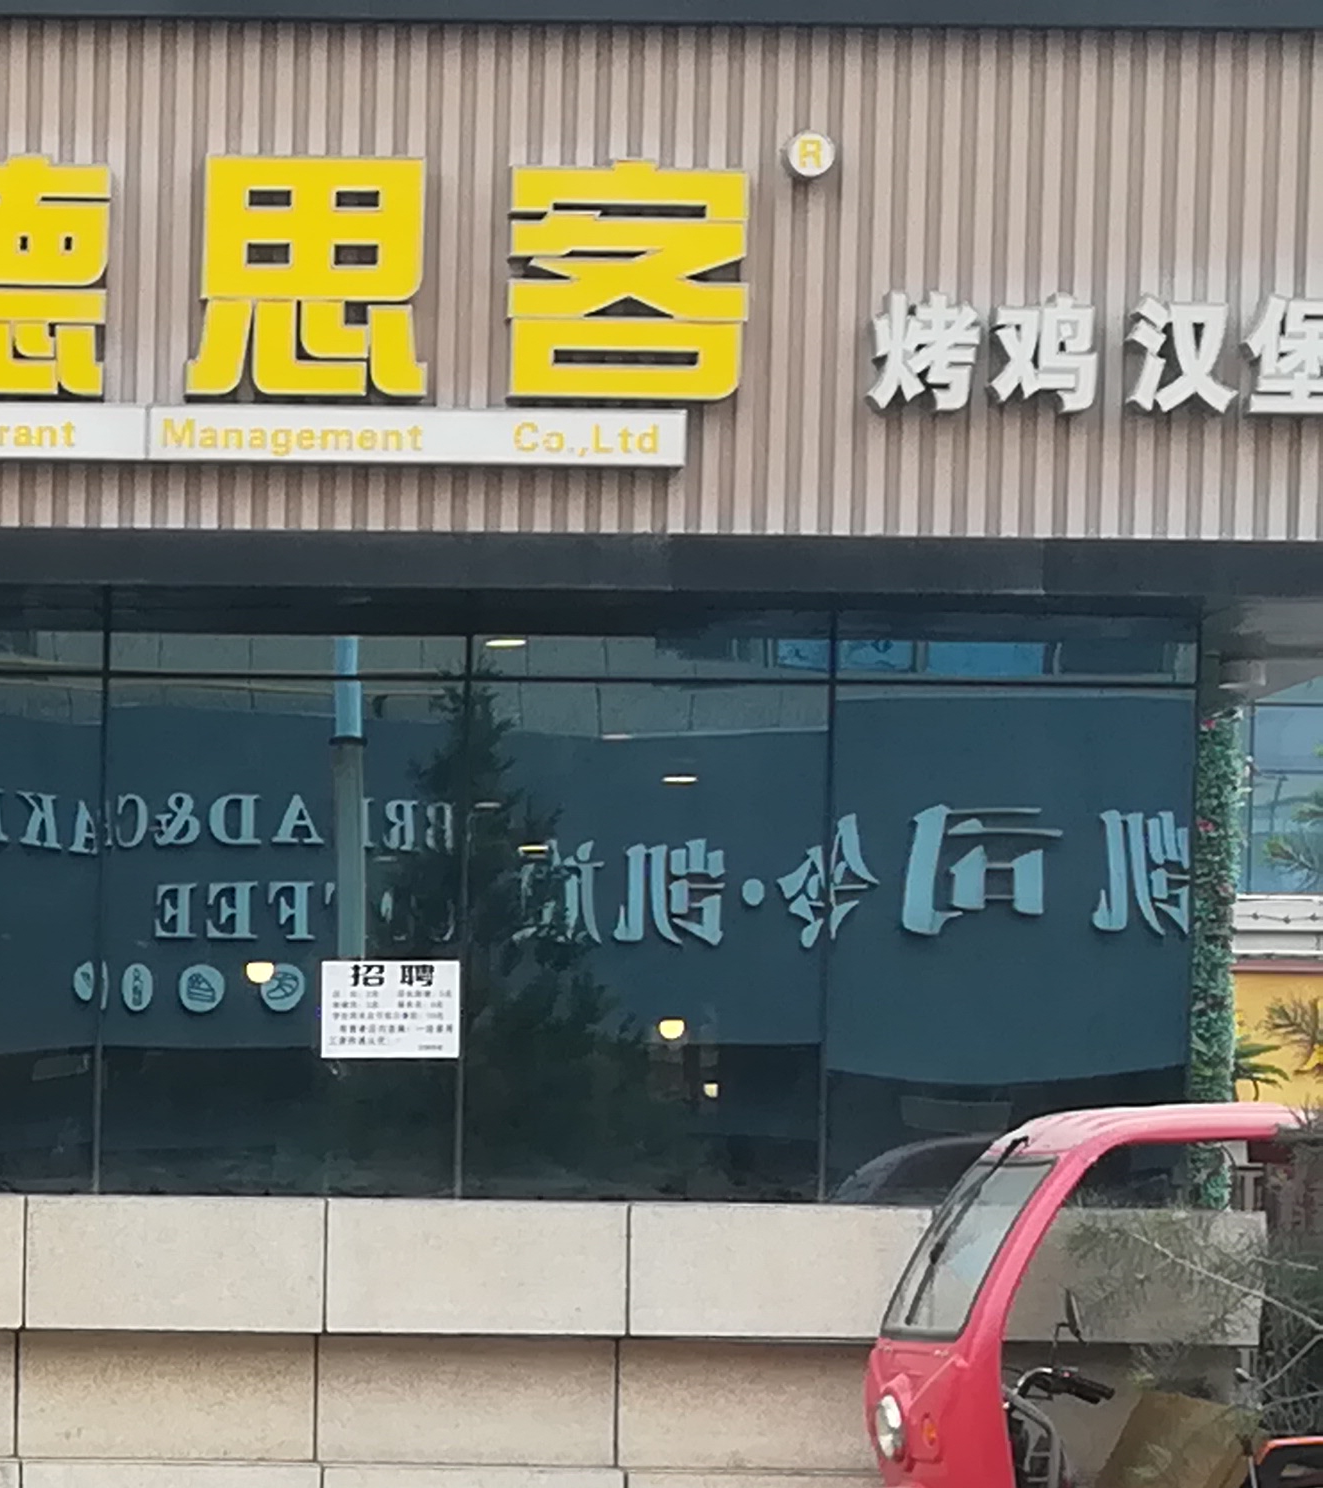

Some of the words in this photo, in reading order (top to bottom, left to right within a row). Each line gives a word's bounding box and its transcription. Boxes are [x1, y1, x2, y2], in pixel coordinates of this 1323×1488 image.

[866, 289, 1323, 413] 烤鸡汉堡
[162, 417, 424, 457] Management
[350, 964, 435, 988] 招聘
